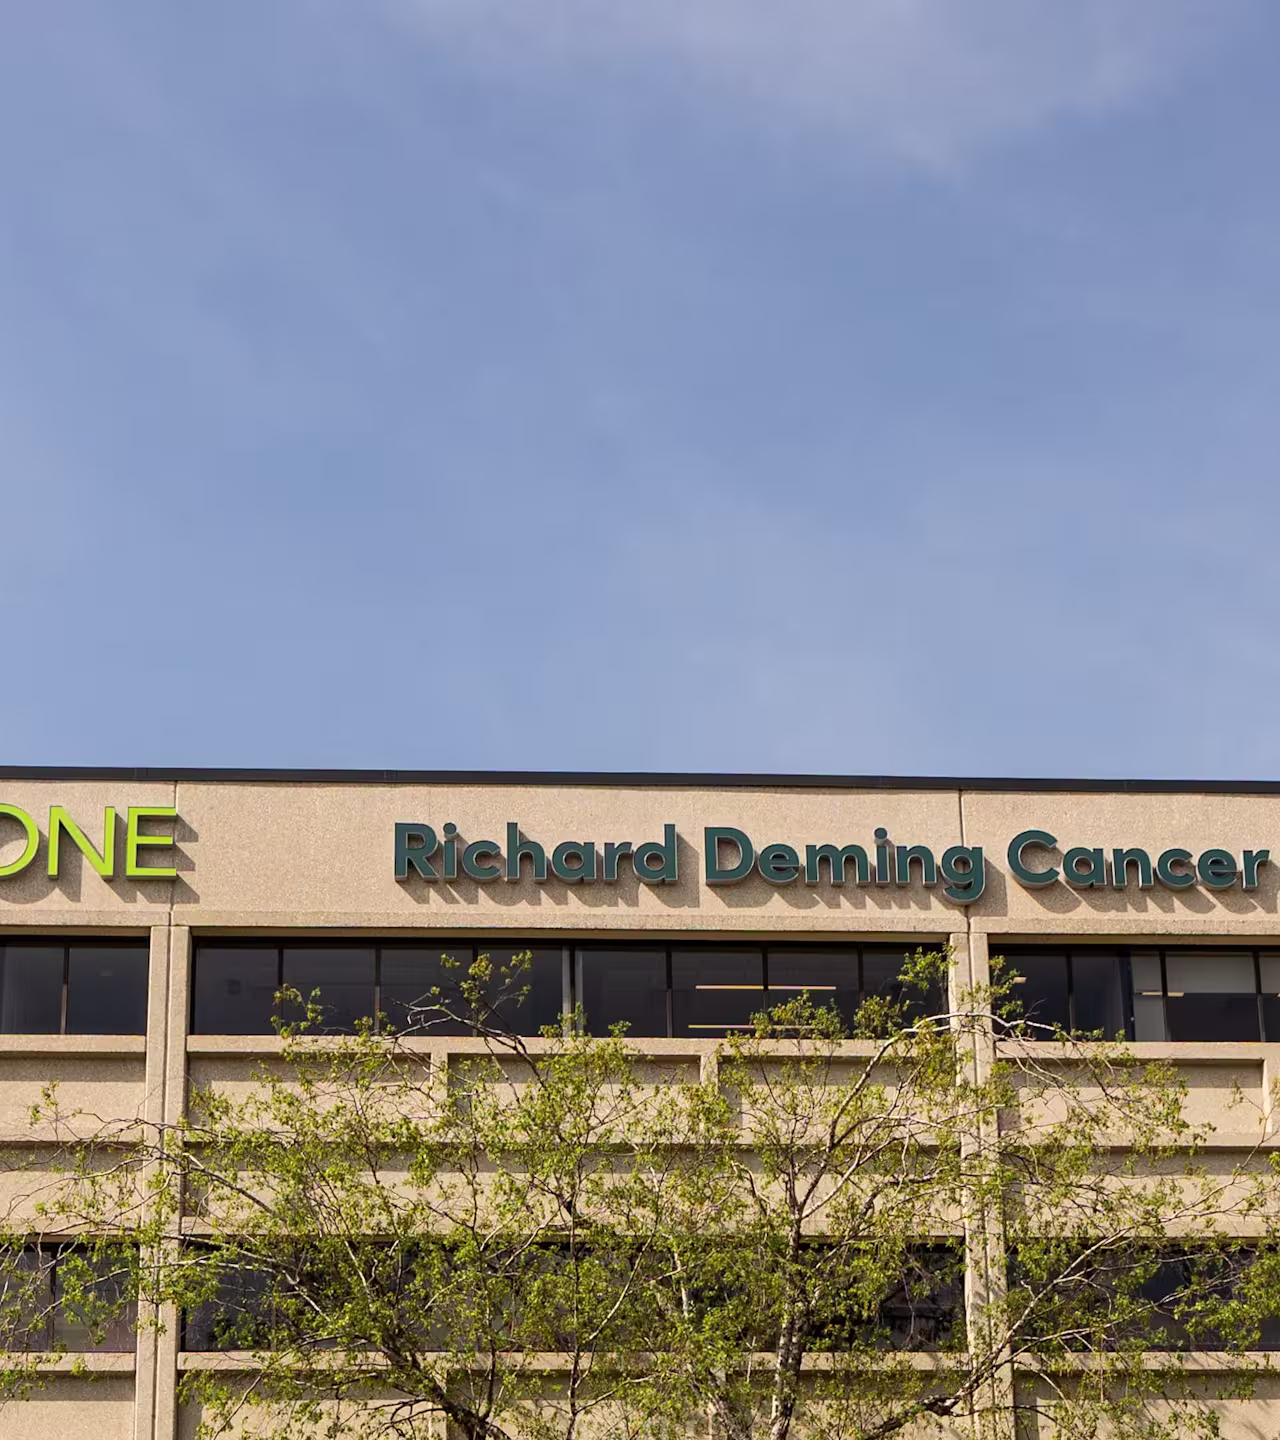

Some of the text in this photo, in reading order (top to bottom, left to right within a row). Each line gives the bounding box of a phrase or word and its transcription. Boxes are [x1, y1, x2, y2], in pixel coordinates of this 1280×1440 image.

[394, 822, 678, 883] Richard
[704, 826, 986, 900] Deming
[1007, 829, 1271, 888] Cancer
